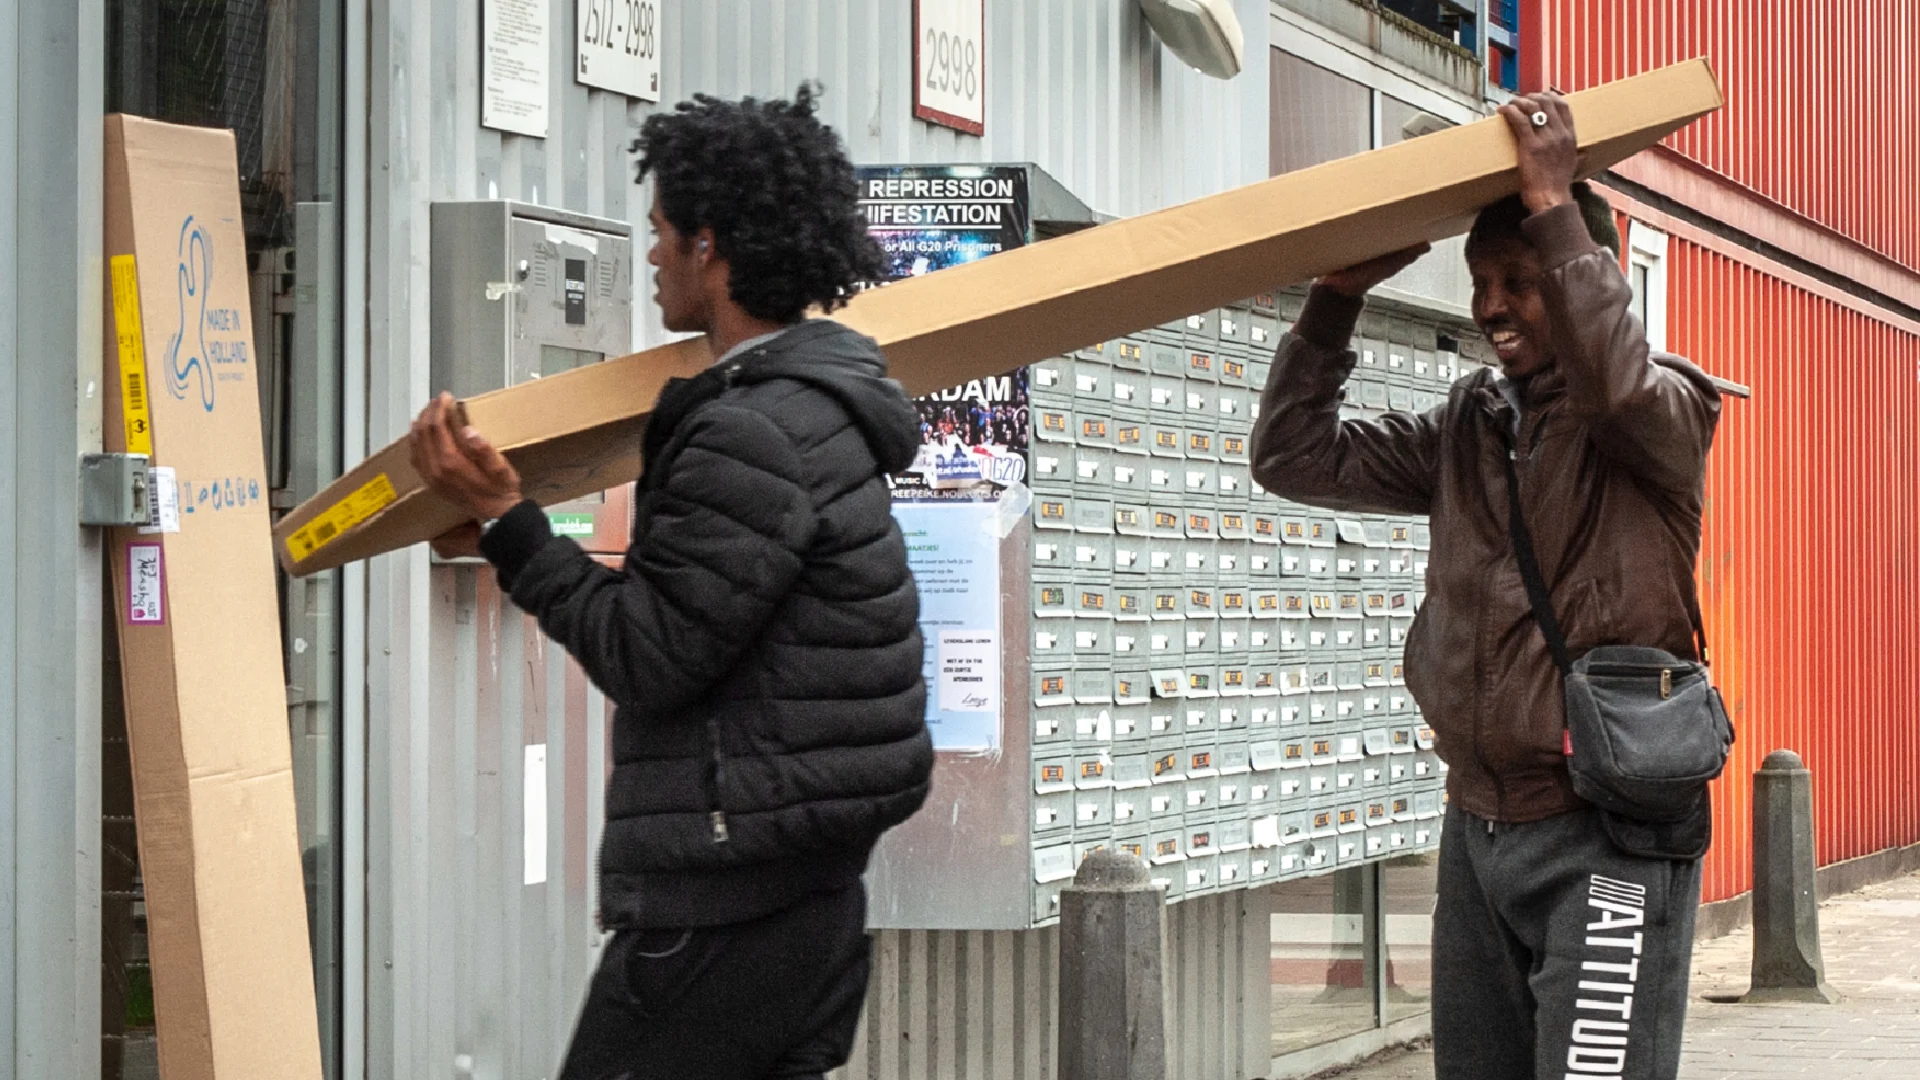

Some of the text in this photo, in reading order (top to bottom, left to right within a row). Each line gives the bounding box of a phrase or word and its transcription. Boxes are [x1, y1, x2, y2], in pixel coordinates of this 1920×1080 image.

[926, 27, 976, 101] 2998
[869, 179, 1013, 198] REPRESSION
[901, 242, 915, 252] All
[945, 241, 1002, 252] Prisoners
[207, 309, 240, 331] MADE IN
[210, 341, 247, 363] HOLLAND
